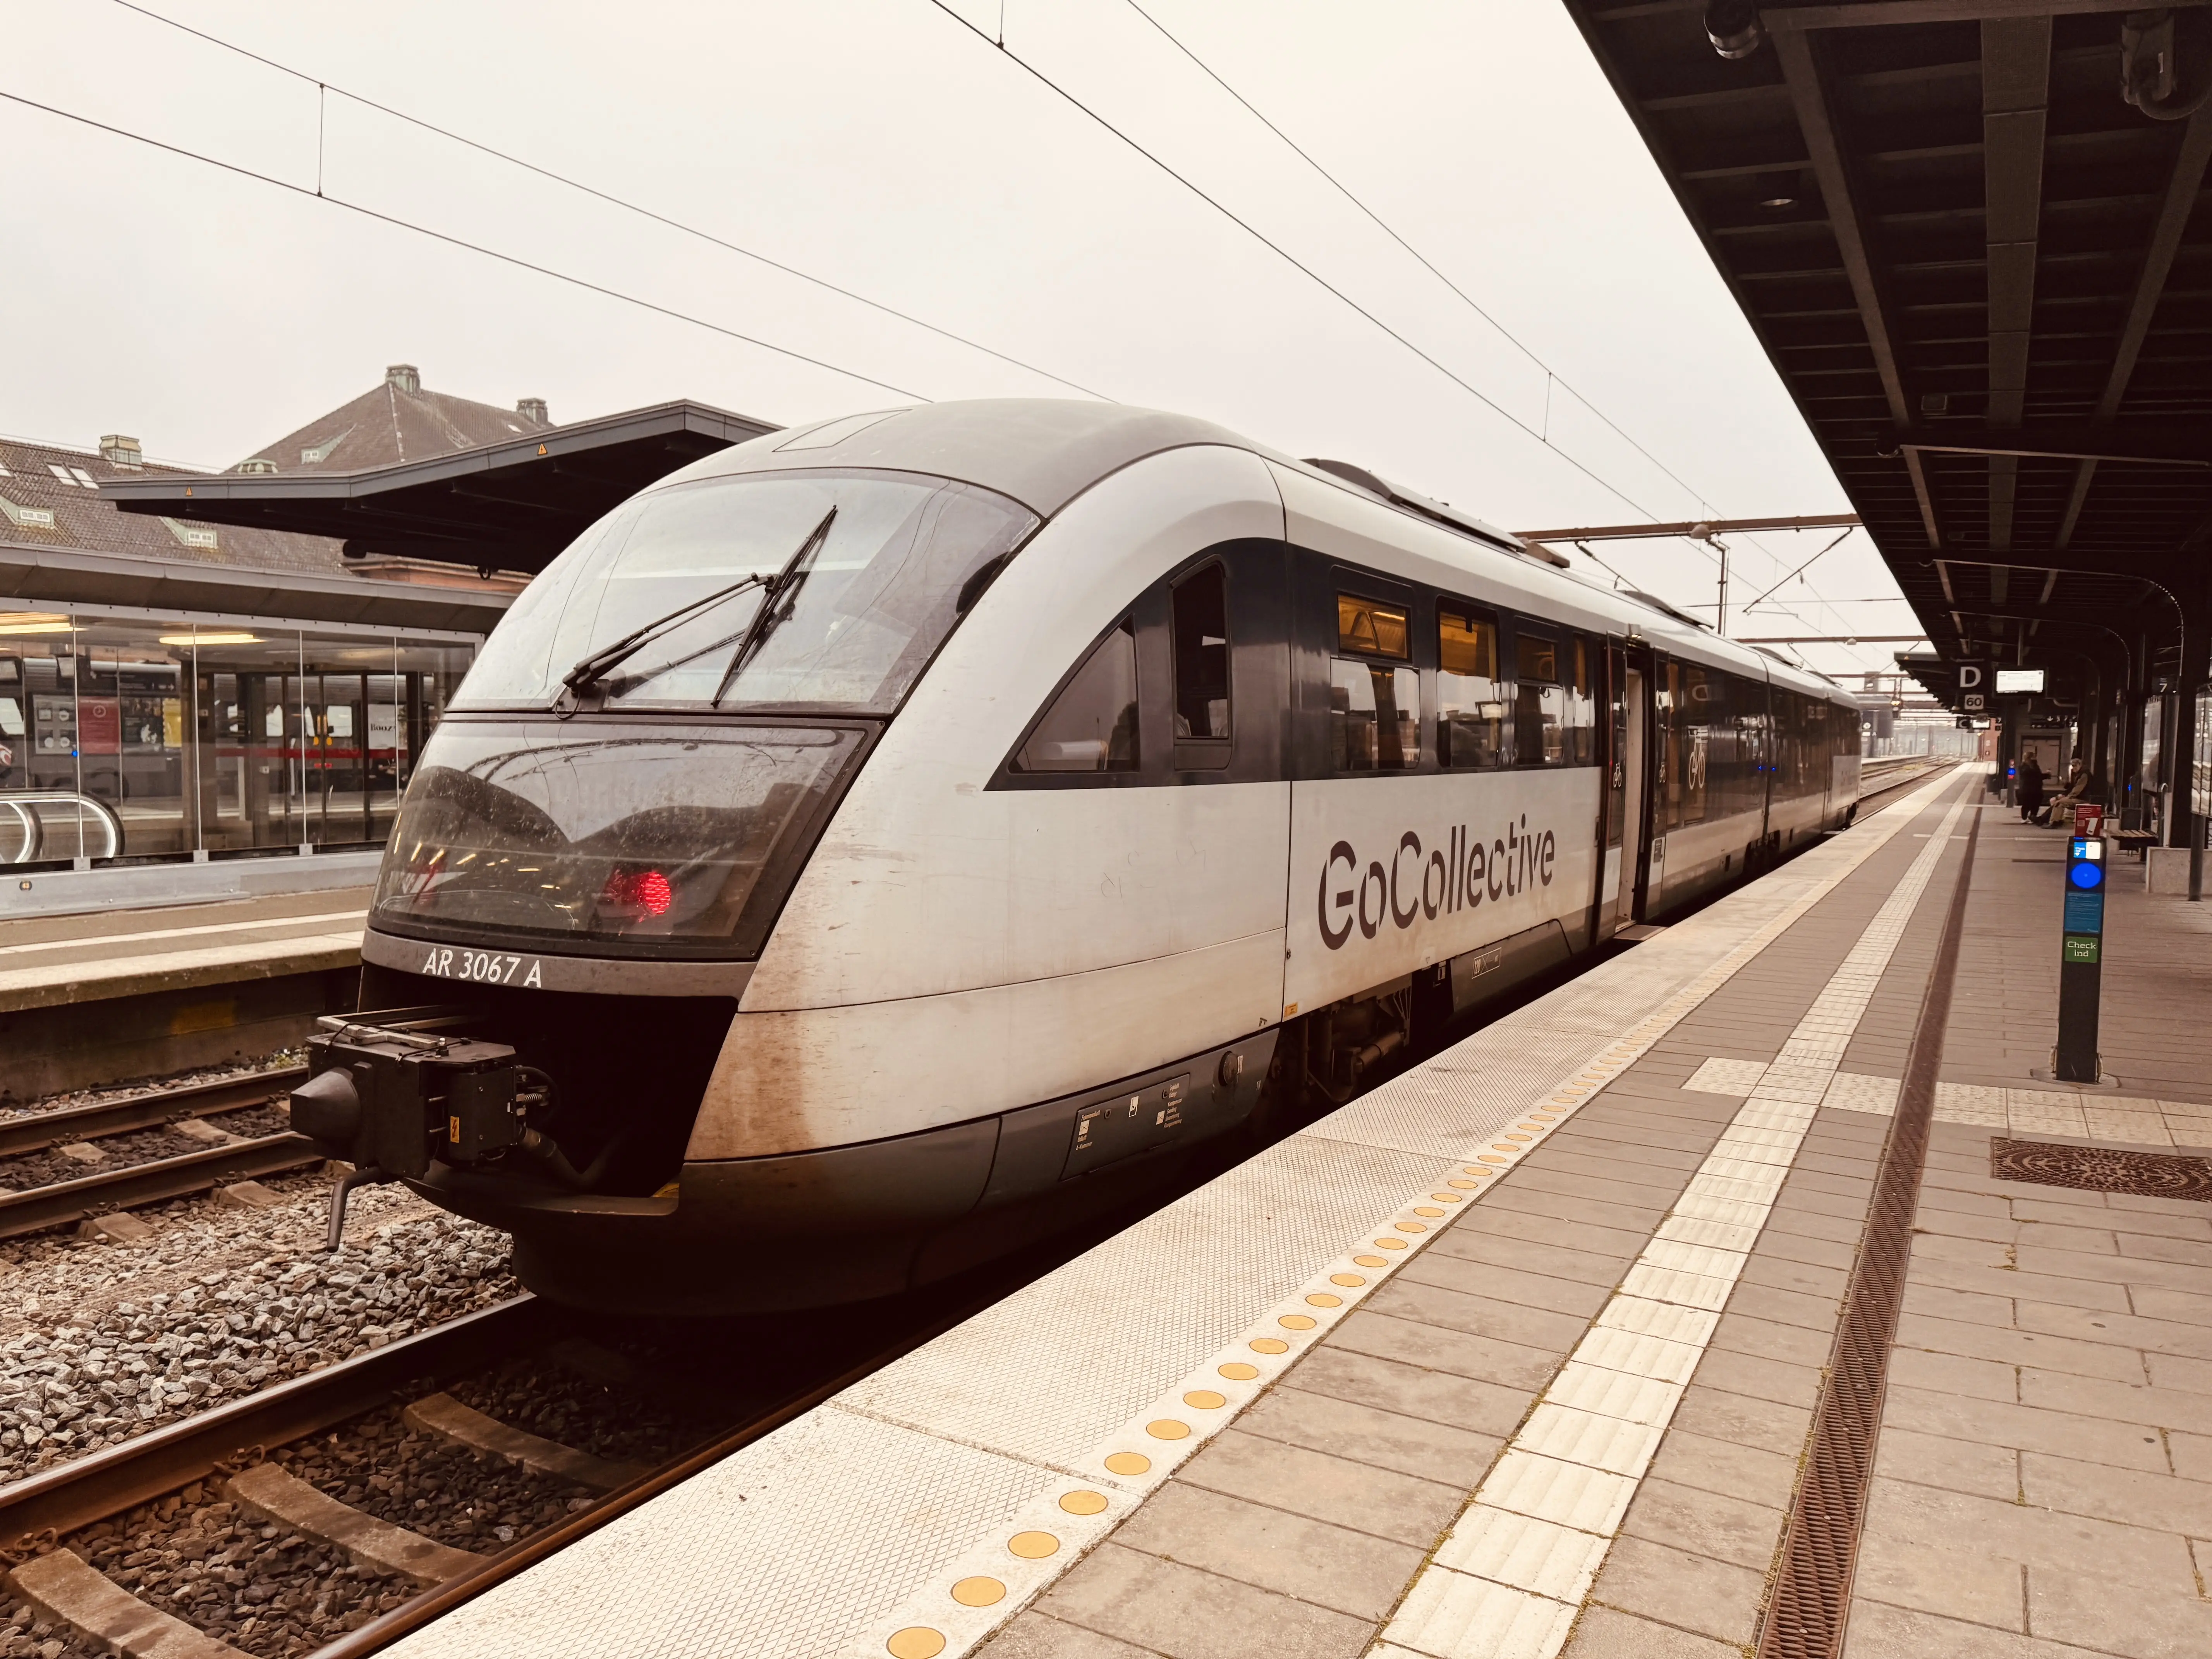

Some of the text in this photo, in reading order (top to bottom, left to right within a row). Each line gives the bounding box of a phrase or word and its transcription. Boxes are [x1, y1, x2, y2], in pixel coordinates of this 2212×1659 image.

[1960, 666, 1981, 688] D
[2159, 683, 2167, 692] 7
[1966, 697, 1982, 706] 60
[1959, 719, 1968, 728] C
[1318, 813, 1554, 951] GoCollective
[2068, 941, 2096, 949] Check
[422, 948, 541, 988] AR 3067 A
